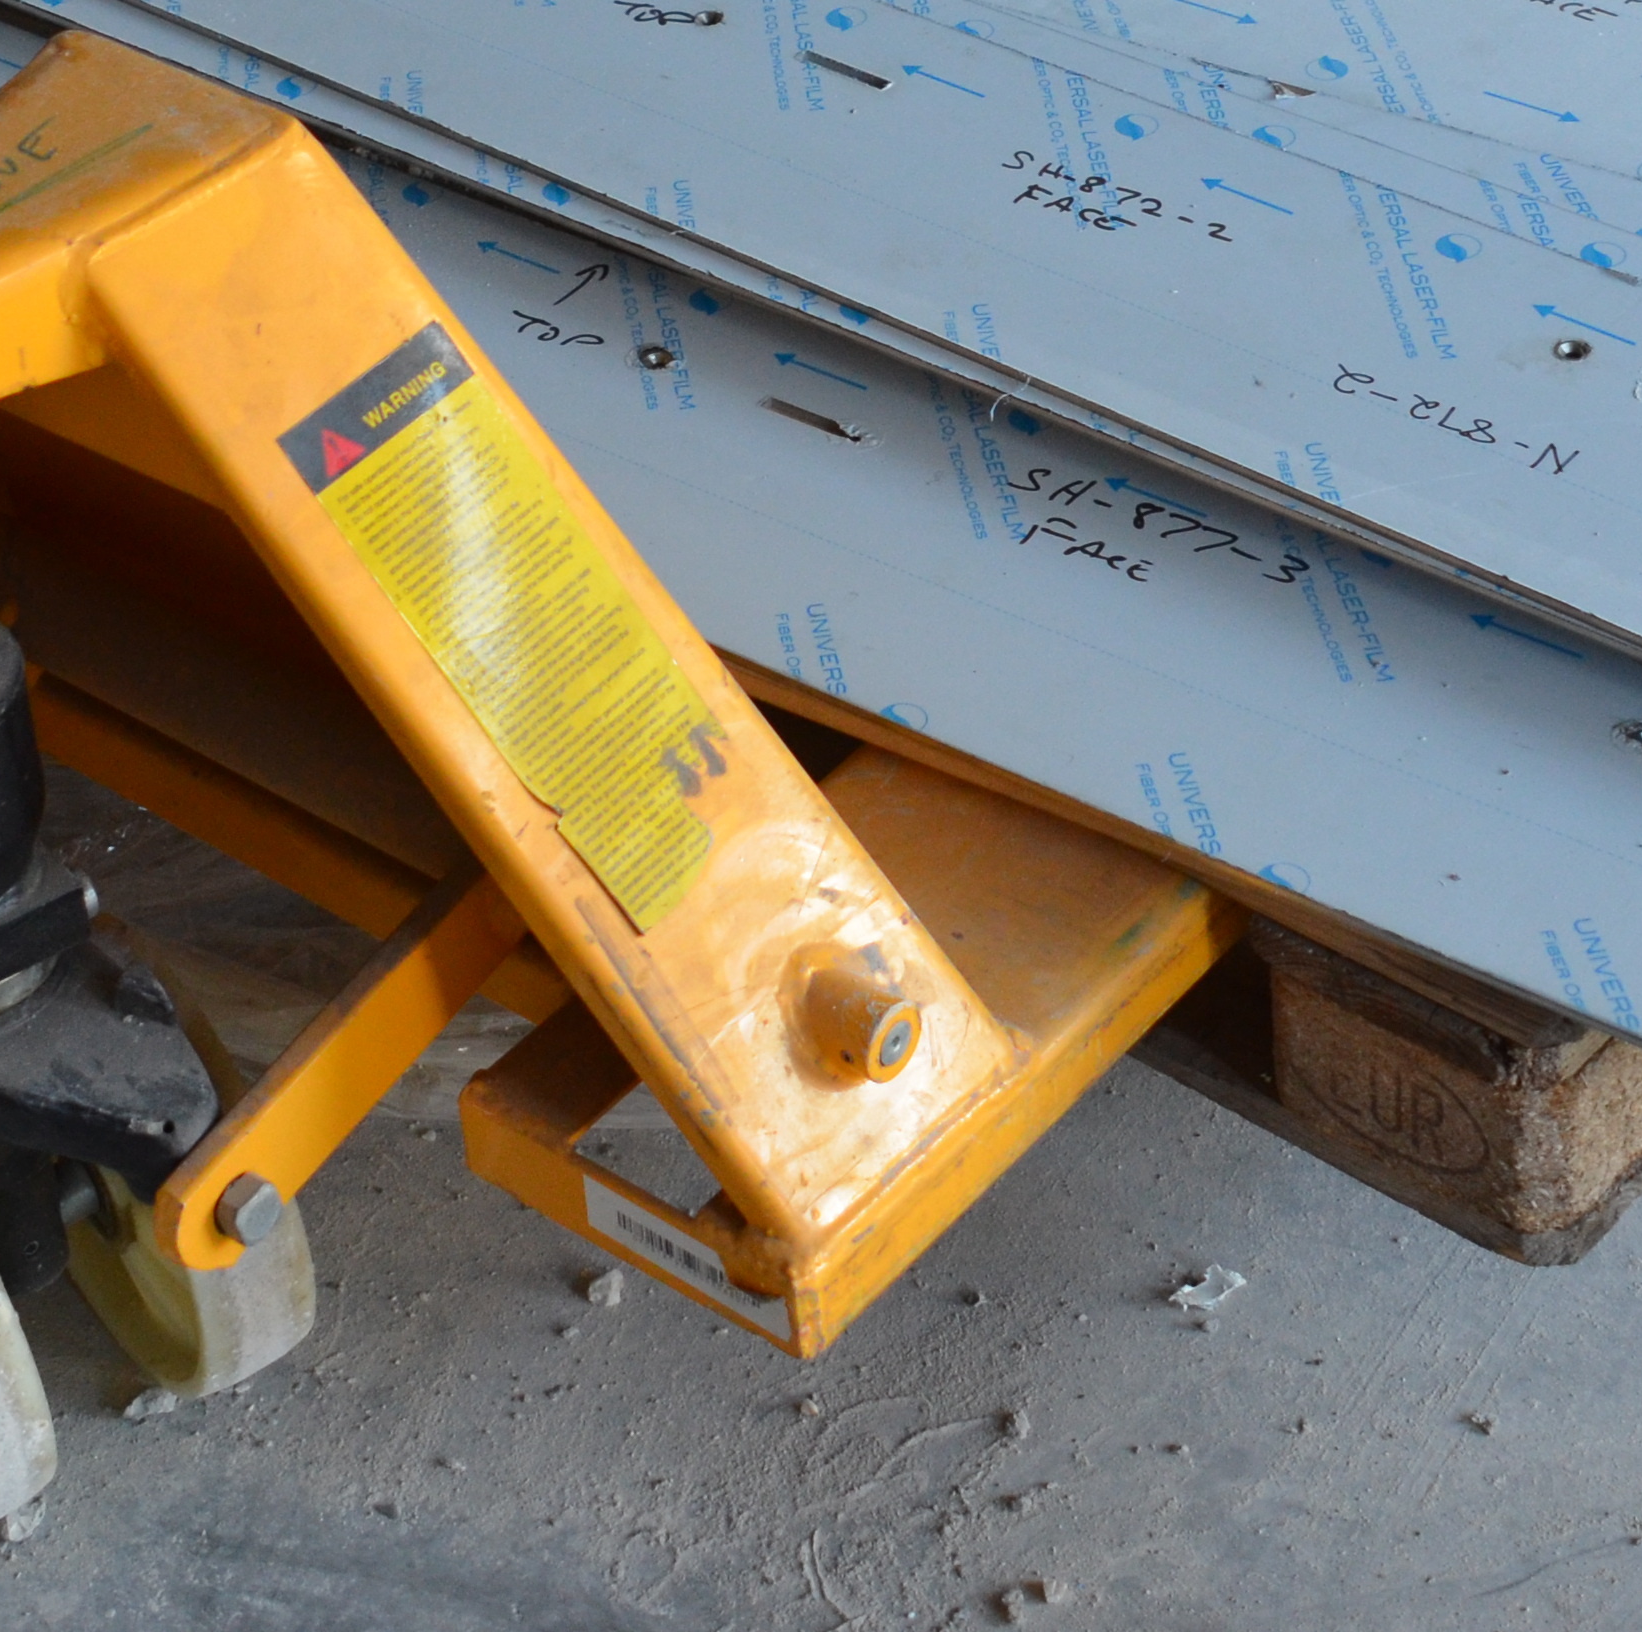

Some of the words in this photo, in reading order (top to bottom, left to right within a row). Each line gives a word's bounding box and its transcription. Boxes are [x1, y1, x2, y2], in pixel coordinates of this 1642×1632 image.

[795, 25, 824, 111] LASR-FILM
[1002, 150, 1232, 242] SH-872-2
[1014, 184, 1137, 231] FACE
[512, 309, 604, 346] TOP
[1374, 267, 1419, 359] TECHNOLOGIES
[1404, 261, 1457, 360] LASER-FILM
[362, 361, 447, 429] WARNING
[1333, 363, 1579, 474] N-872-2
[953, 443, 988, 540] TECHNOLOGIES
[974, 426, 1026, 540] LASER-FILM
[1008, 468, 1310, 583] SH-877-3
[775, 612, 795, 654] FIBER
[1300, 575, 1354, 683] TECHNOLOGIES
[1325, 558, 1395, 683] LASER-FILM
[1135, 763, 1160, 807] FIBER
[1540, 930, 1570, 980] FIBER
